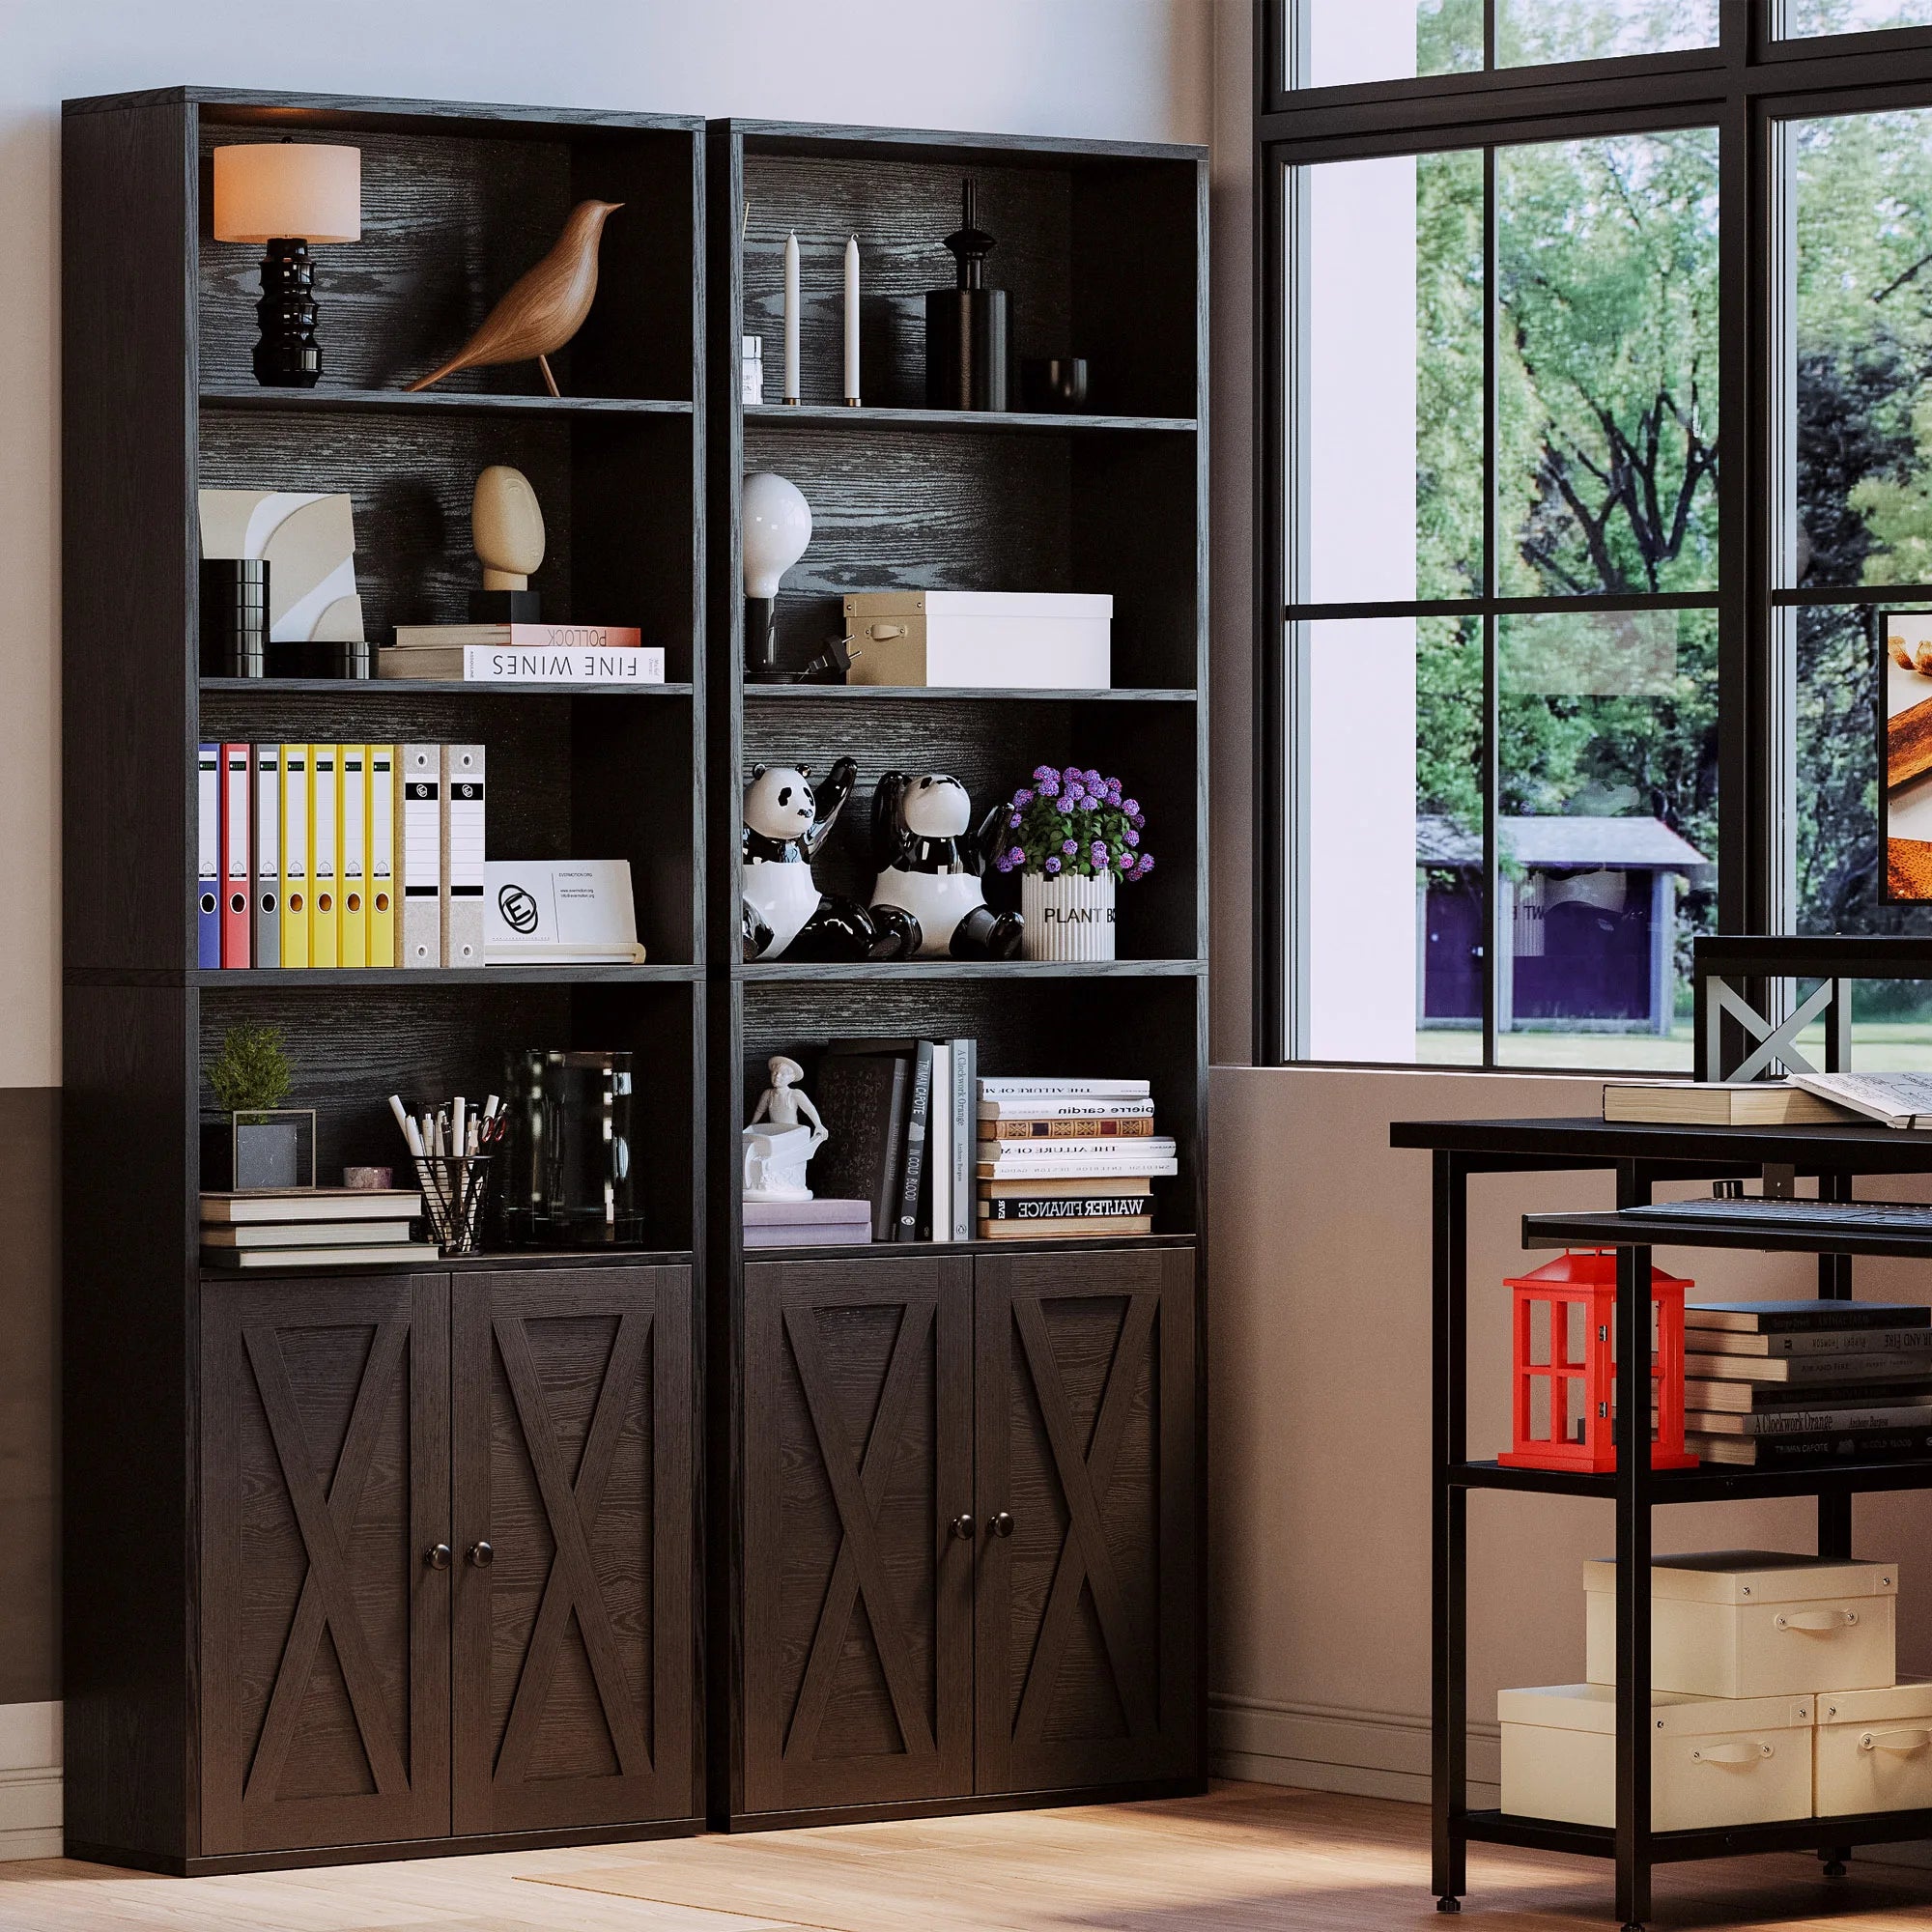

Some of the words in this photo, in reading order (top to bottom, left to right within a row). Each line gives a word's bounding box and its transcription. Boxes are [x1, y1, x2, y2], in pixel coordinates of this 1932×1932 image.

[548, 629, 607, 646] POLLOCK
[493, 655, 573, 675] WINES
[584, 656, 637, 676] FINE
[1044, 908, 1102, 923] PLANT
[918, 1060, 930, 1086] TRUMAN
[957, 1057, 966, 1096] Clockwork
[913, 1087, 927, 1115] CAPOTE
[956, 1096, 966, 1126] Orange
[907, 1156, 920, 1175] COLD
[904, 1178, 918, 1202] BLOOD
[1885, 1334, 1901, 1350] FIRE
[1904, 1333, 1922, 1346] AND
[1754, 1417, 1762, 1434] A
[1762, 1414, 1804, 1434] Clockwork
[1804, 1413, 1833, 1431] Orange
